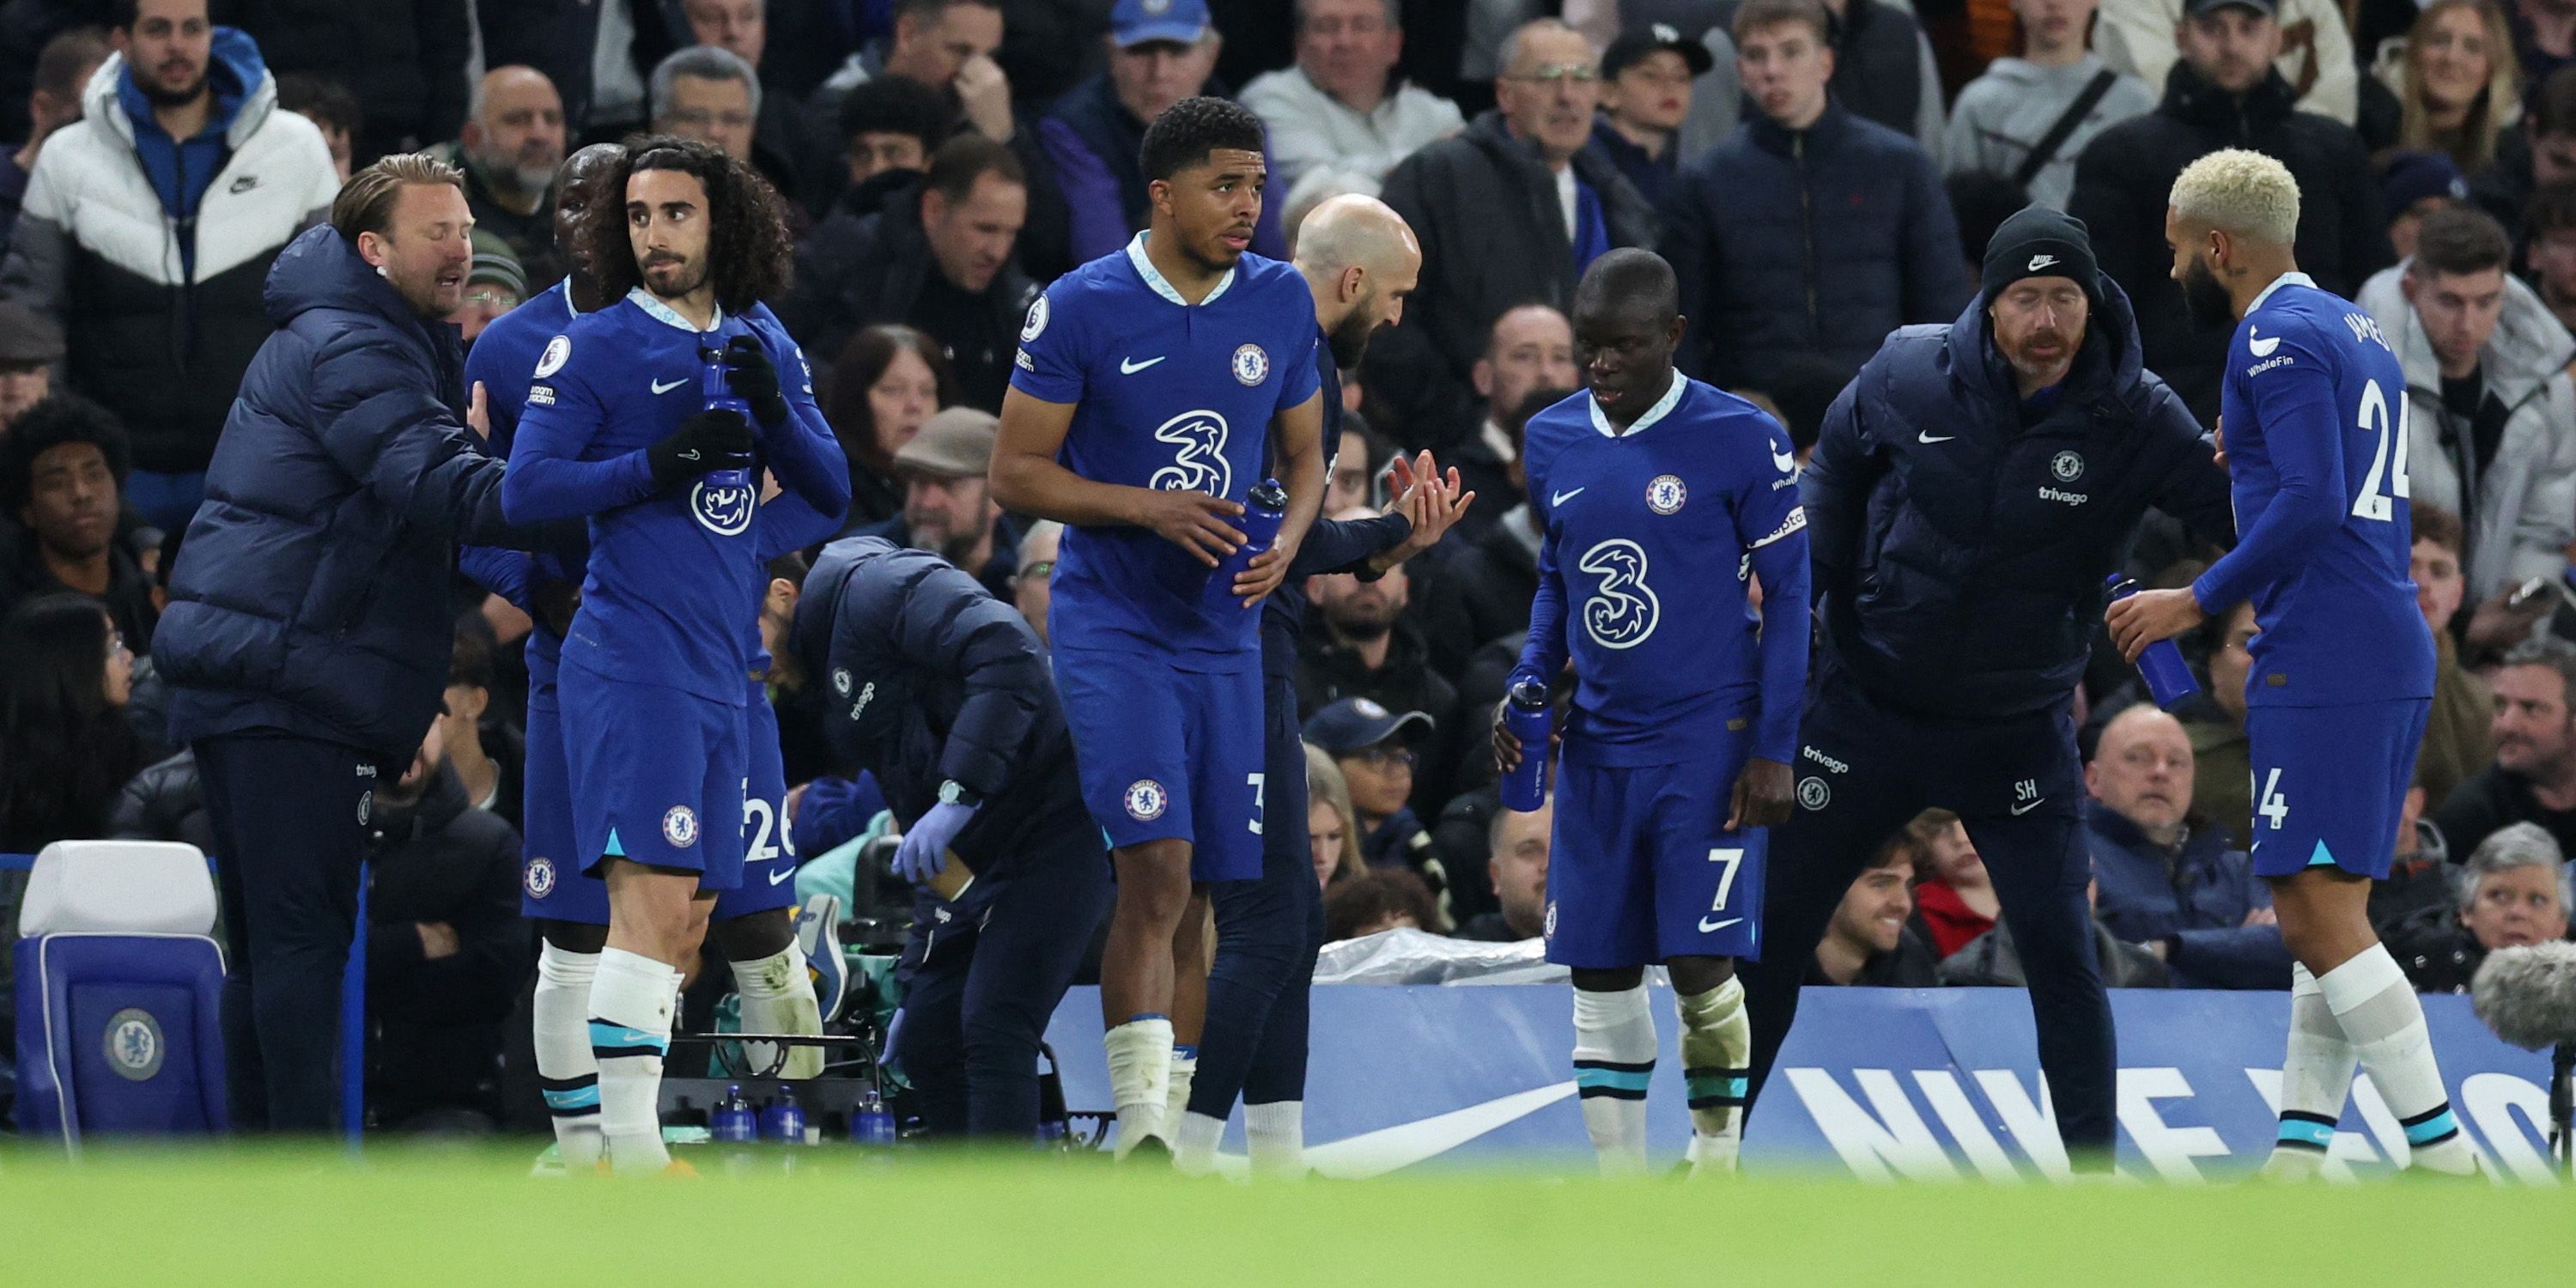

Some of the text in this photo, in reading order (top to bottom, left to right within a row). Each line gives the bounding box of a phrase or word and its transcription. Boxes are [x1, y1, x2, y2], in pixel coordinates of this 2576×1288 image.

[2246, 355, 2293, 378] WhaleFin
[2038, 486, 2088, 506] trivago
[851, 682, 875, 720] trivago
[1803, 745, 1849, 773] trivago
[2014, 779, 2037, 800] SH
[1708, 848, 1744, 910] 7
